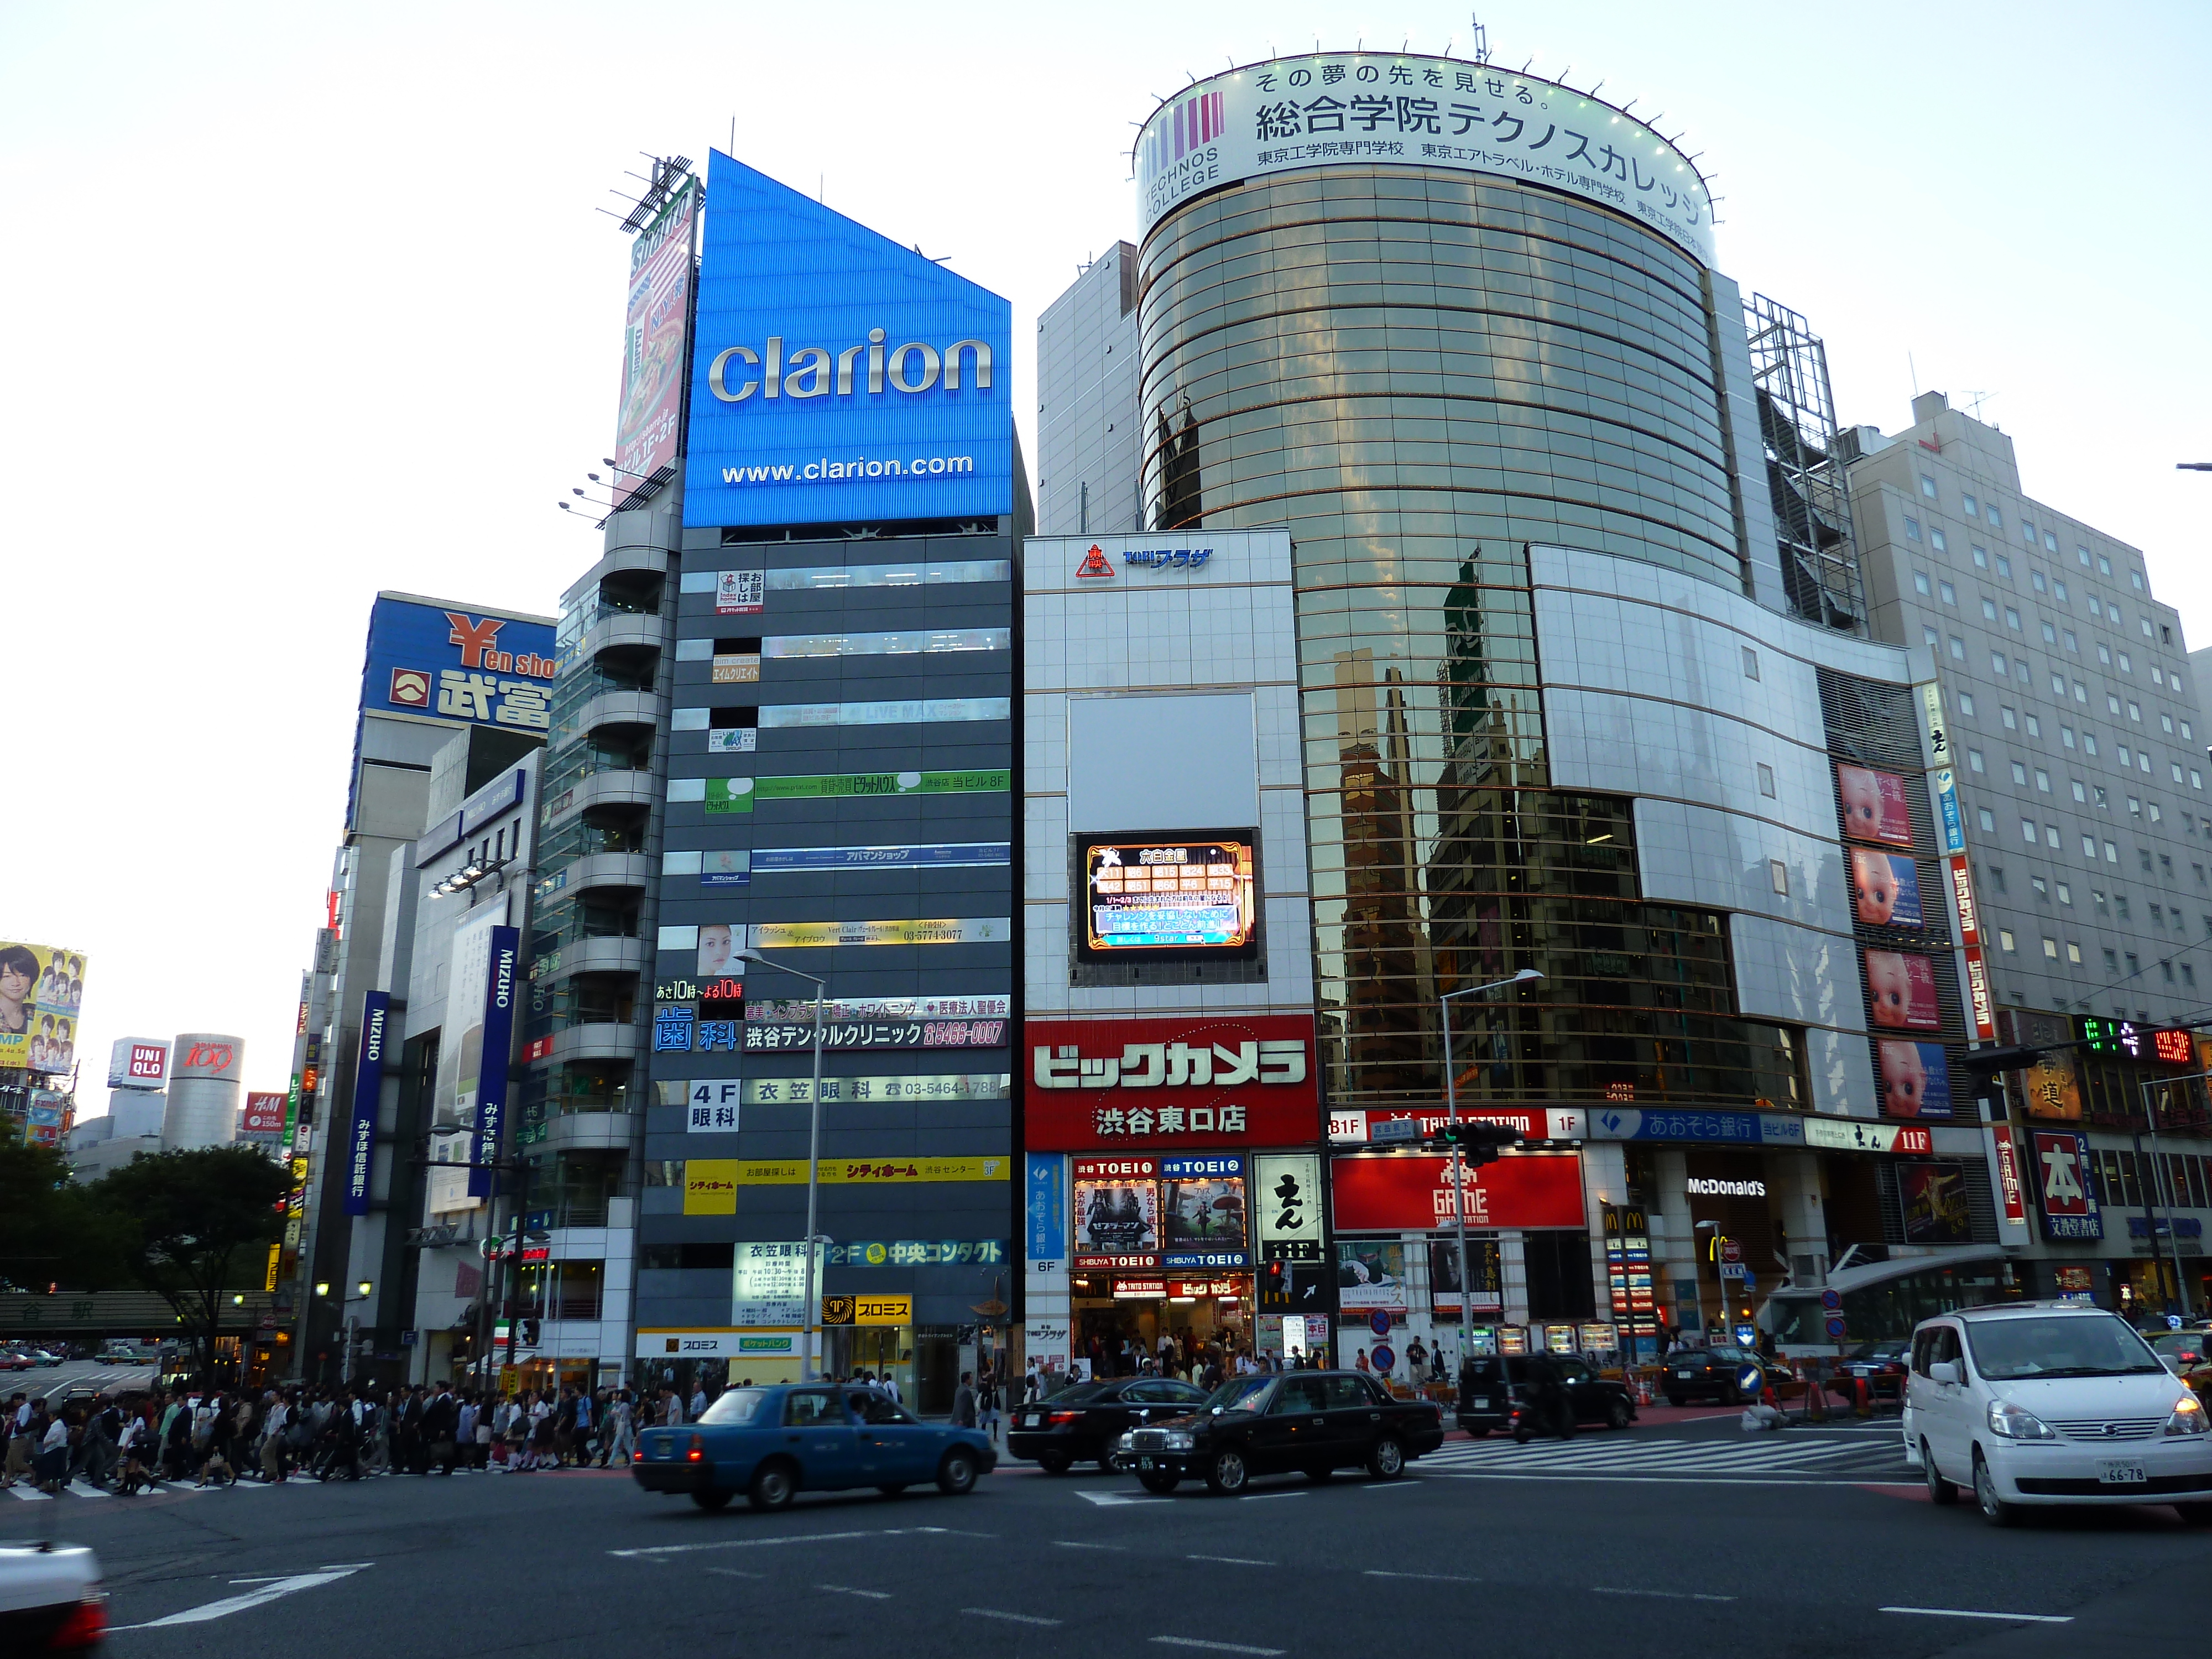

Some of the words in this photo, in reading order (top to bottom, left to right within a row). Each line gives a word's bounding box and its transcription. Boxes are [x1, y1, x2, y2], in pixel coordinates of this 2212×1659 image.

[1255, 64, 1548, 111] その夢の先を見せる。
[1255, 94, 1699, 225] 総合学院テクノスカレッジ
[1256, 140, 1405, 166] 東京工学院専門学校
[1145, 147, 1219, 206] TECHNOS
[1145, 163, 1219, 224] COLLEGE
[709, 328, 993, 403] clarion
[722, 455, 973, 484] www.clarion.com
[1088, 549, 1103, 568] 東映
[1123, 549, 1213, 568] TOEIプラザ
[738, 573, 749, 603] 探しは
[749, 572, 762, 602] お部屋
[732, 656, 759, 664] create
[713, 667, 758, 681] エイムクリエイト
[853, 775, 895, 794] ピタットハウス
[925, 778, 950, 787] 渋谷店
[953, 777, 986, 789] 当ビル
[990, 775, 1004, 787] 8F
[1943, 794, 1959, 846] あおぞら銀行
[847, 849, 909, 862] アパマンショップ
[1140, 848, 1188, 864] 六白金星
[1953, 868, 1975, 932] ビックカメラ
[752, 926, 786, 934] アイラッシュ
[794, 935, 825, 943] アイブロウ
[904, 930, 962, 941] 03-5774-3077
[496, 949, 513, 1009] MIZUHO
[1968, 960, 1990, 1025] ビックカメラ
[858, 1002, 916, 1018] ホワイトニング
[940, 1000, 1006, 1015] 医療法人聖優会
[368, 1009, 385, 1062] MIZUHO
[656, 1006, 737, 1051] 歯科
[747, 1023, 921, 1048] 渋谷デンタルクリニック
[936, 1021, 1003, 1044] 5466-0007
[135, 1048, 160, 1062] UNI
[183, 1047, 233, 1075] 109
[1034, 1040, 1306, 1088] ビックカメラ
[133, 1062, 160, 1075] QLO
[905, 1081, 997, 1095] 03-5464-1788
[254, 1096, 281, 1112] H&M
[692, 1107, 735, 1127] 眼科
[1096, 1105, 1246, 1135] 渋谷東口店
[1558, 1116, 1575, 1131] 1F
[1649, 1114, 1751, 1138] あおぞら銀行
[1901, 1131, 1927, 1150] 11F
[351, 1119, 371, 1198] みずほ信託銀行
[1097, 1162, 1139, 1173] TOEI
[1164, 1164, 1180, 1172] 渋谷
[1182, 1161, 1225, 1172] TOEI
[846, 1164, 919, 1178] シティホーム
[925, 1166, 975, 1175] 渋谷センター
[690, 1181, 733, 1190] シティホーム
[1688, 1178, 1766, 1197] McDonald's
[1035, 1190, 1046, 1254] あおぞら銀行
[2050, 1217, 2099, 1237] 文教堂書店
[750, 1244, 808, 1258] 衣笠眼科
[831, 1245, 860, 1264] 2F
[889, 1241, 1003, 1264] 中央コンタクト
[1198, 1255, 1232, 1265] TOEI
[1038, 1261, 1055, 1272] 6F
[1109, 1256, 1143, 1266] TOEI
[858, 1302, 908, 1317] プロミス
[683, 1339, 718, 1350] プロミス
[2109, 1469, 2143, 1481] 66-78
